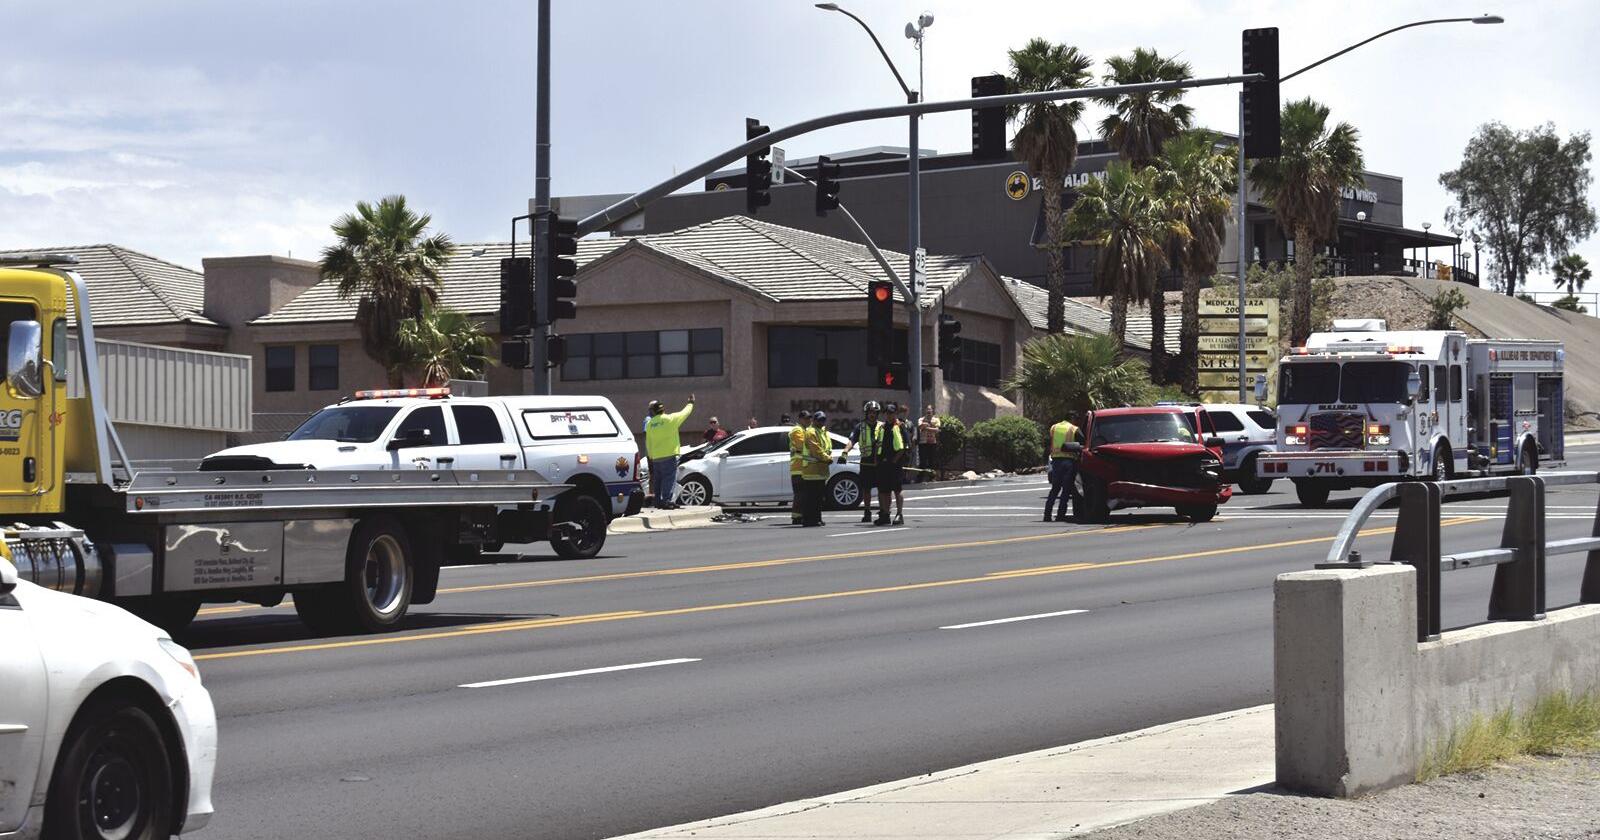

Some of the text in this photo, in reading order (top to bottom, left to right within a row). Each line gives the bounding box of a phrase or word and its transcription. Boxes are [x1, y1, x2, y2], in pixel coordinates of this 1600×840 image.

[917, 253, 926, 268] 95
[1226, 375, 1254, 383] labcrp
[1315, 462, 1336, 473] 711
